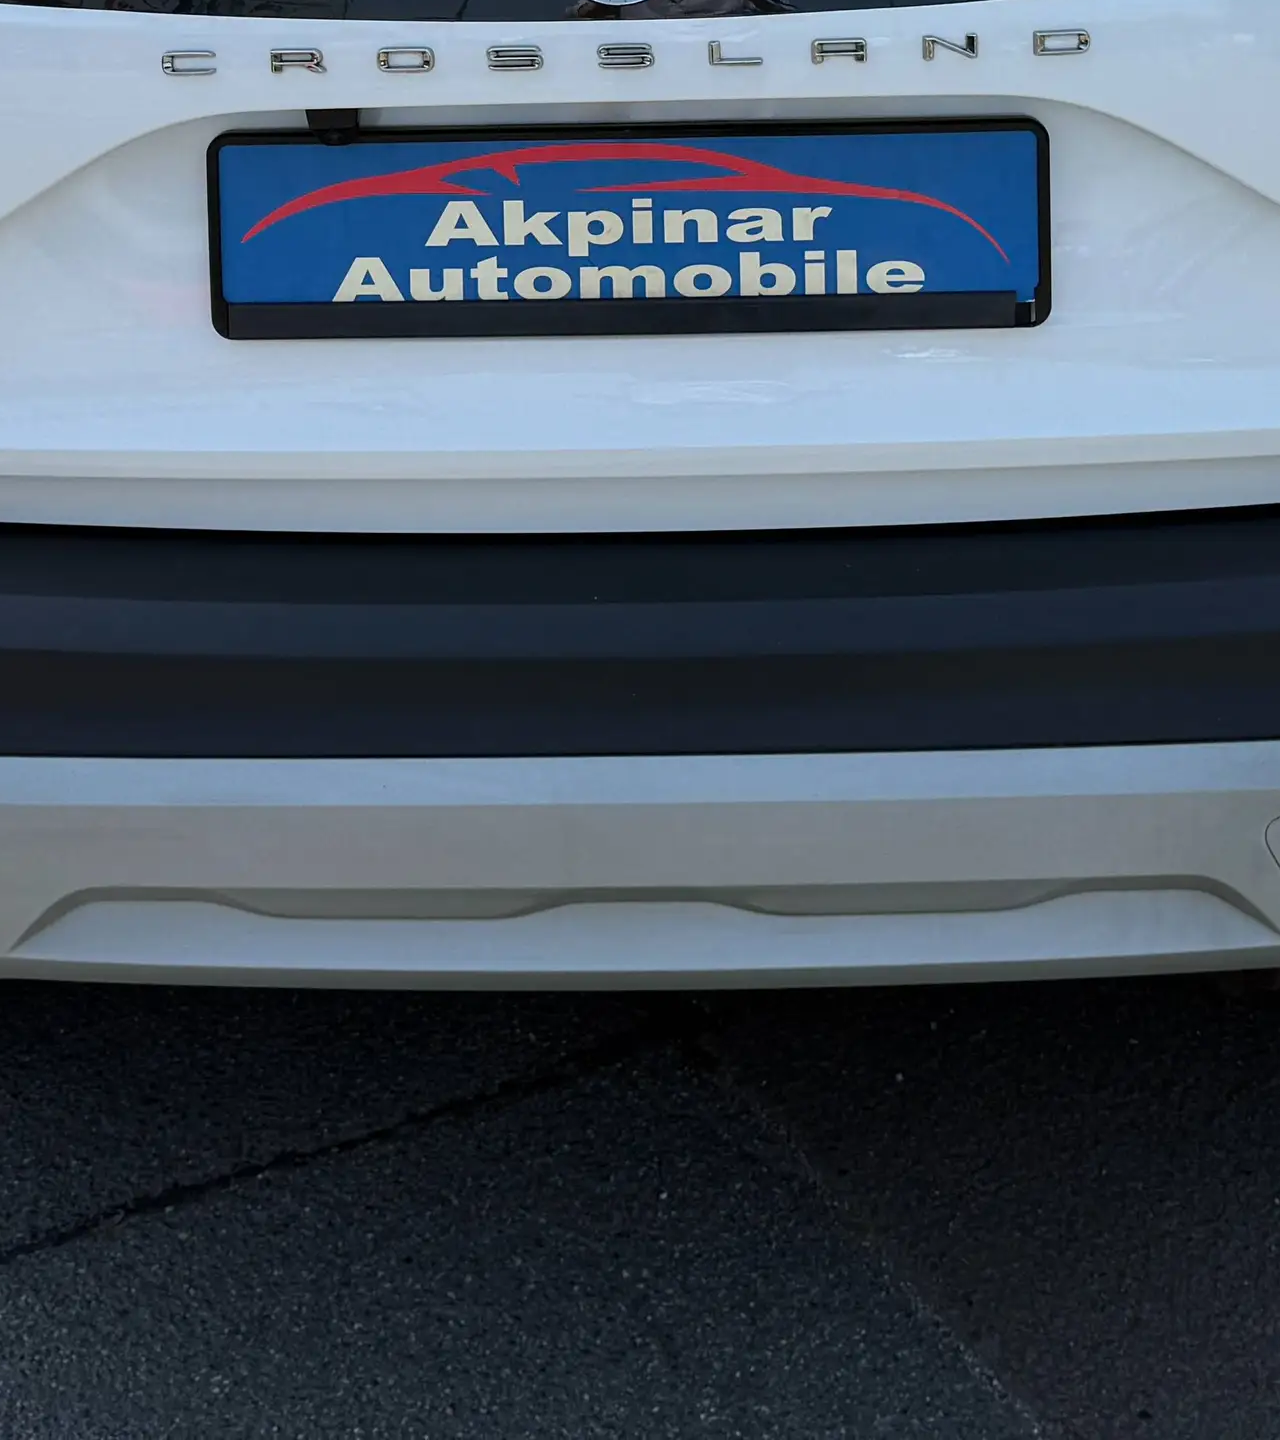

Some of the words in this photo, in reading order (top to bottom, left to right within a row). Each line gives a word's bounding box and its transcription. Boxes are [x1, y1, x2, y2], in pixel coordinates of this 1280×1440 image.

[160, 28, 1091, 76] CROSSLAND
[425, 198, 833, 257] Akpinar
[332, 250, 926, 303] Automobile
